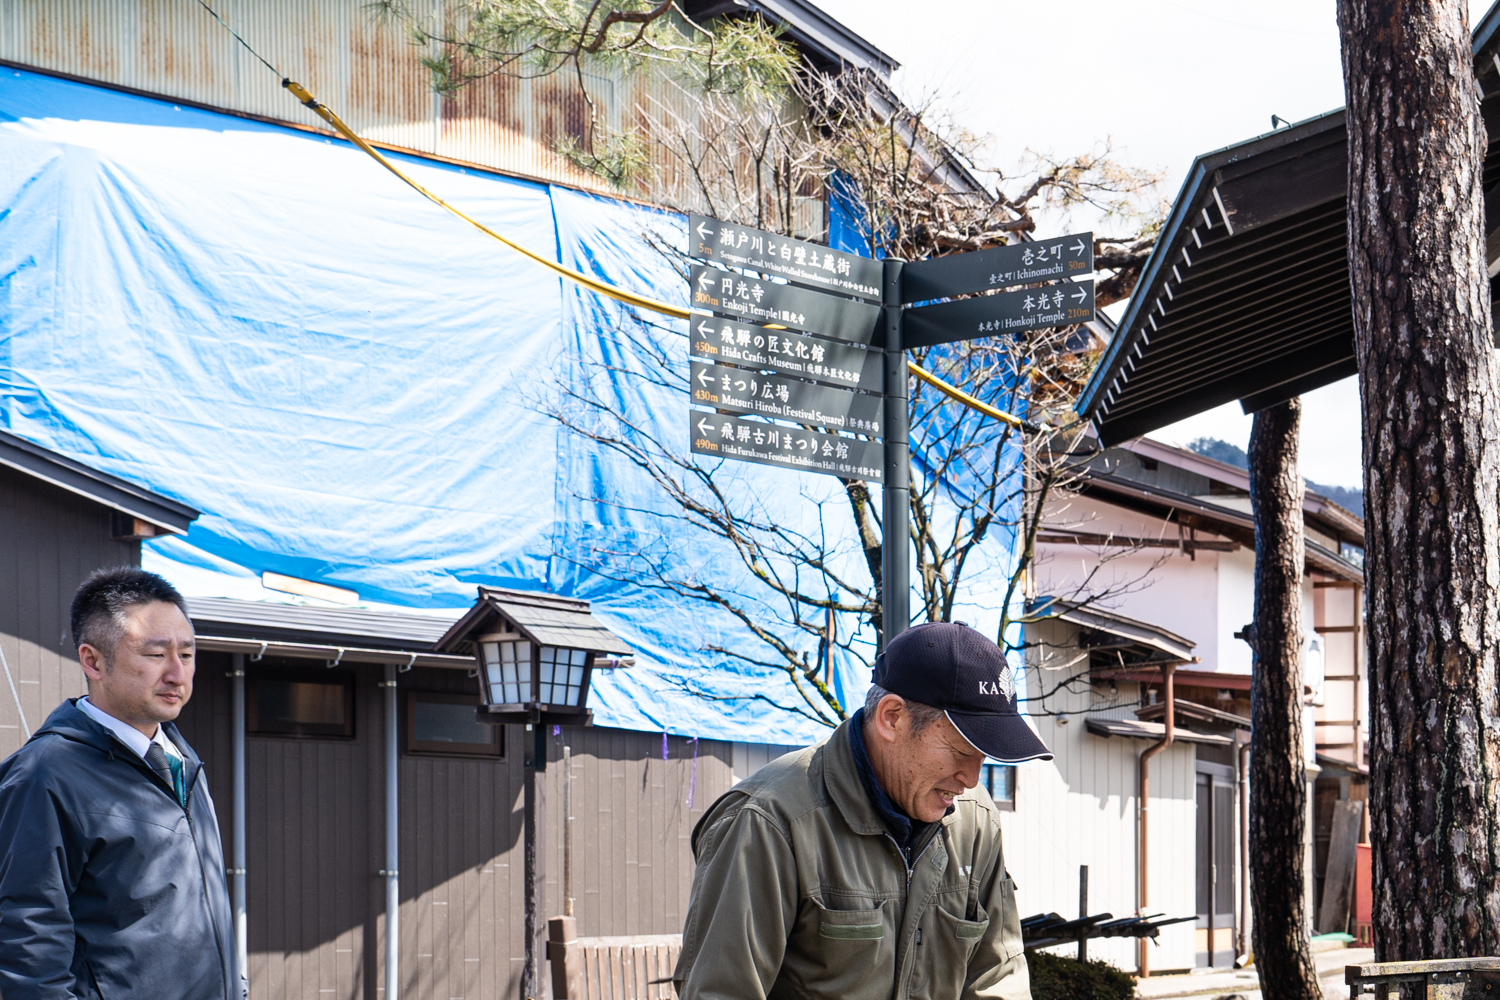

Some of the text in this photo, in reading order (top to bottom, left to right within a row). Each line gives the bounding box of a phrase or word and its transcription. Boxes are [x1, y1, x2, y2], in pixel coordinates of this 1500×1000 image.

[699, 243, 713, 255] 5m
[720, 227, 851, 277] 瀬戸川と白壁土蔵街
[1021, 243, 1064, 266] 壱之町
[720, 250, 747, 264] Setogawa
[765, 261, 781, 273] White
[1017, 263, 1064, 280] Ichinomachi
[1068, 261, 1086, 271] 50m
[695, 291, 719, 306] 300m
[721, 277, 765, 302] 円光寺
[1022, 289, 1065, 312] 本光寺
[722, 299, 749, 316] Enkoji
[750, 304, 778, 320] Temple
[1005, 310, 1065, 328] Honkoji Temple
[1067, 307, 1090, 319] 210m
[978, 319, 1001, 332] 本光寺
[695, 341, 718, 355] 450m
[721, 325, 826, 363] 飛騨の匠文化館
[721, 345, 802, 372] Hida Crafts Museum
[695, 389, 719, 403] 430m
[721, 374, 790, 403] まつり広場
[721, 393, 845, 427] Matsuri Hiroba (Festival Square)
[695, 438, 719, 451] 490m
[721, 422, 849, 460] 飛騨古川まつり会館
[721, 443, 836, 471] Hida Furukawa Festival Exhibition Hall
